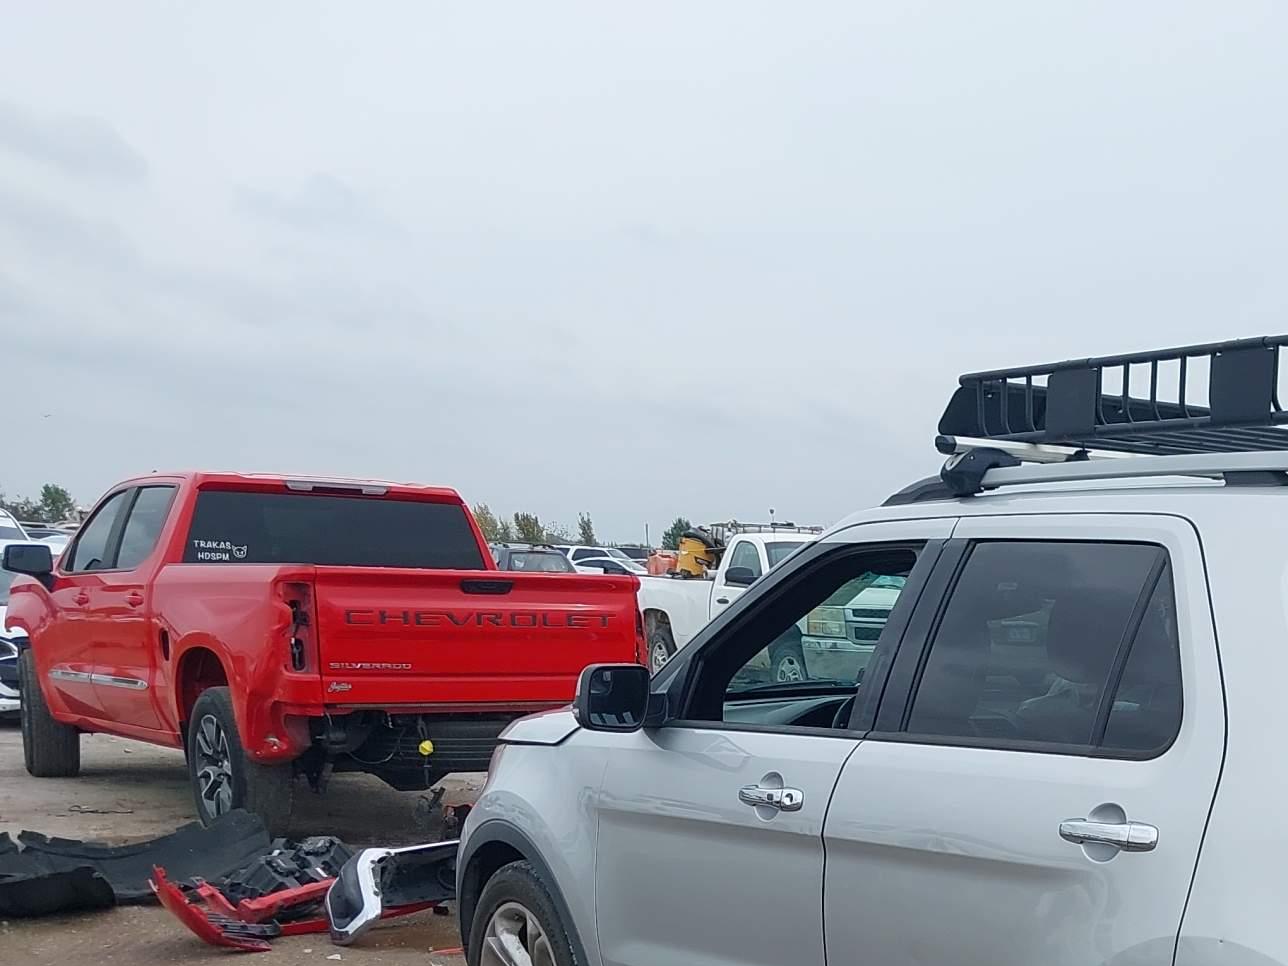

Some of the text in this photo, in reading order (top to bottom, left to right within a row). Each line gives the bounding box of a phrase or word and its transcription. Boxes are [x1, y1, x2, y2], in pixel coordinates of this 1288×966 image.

[193, 540, 231, 550] TRAKAS
[197, 551, 230, 561] HDSPM
[344, 608, 617, 629] CHEVROLET
[328, 661, 413, 670] SILVERADO
